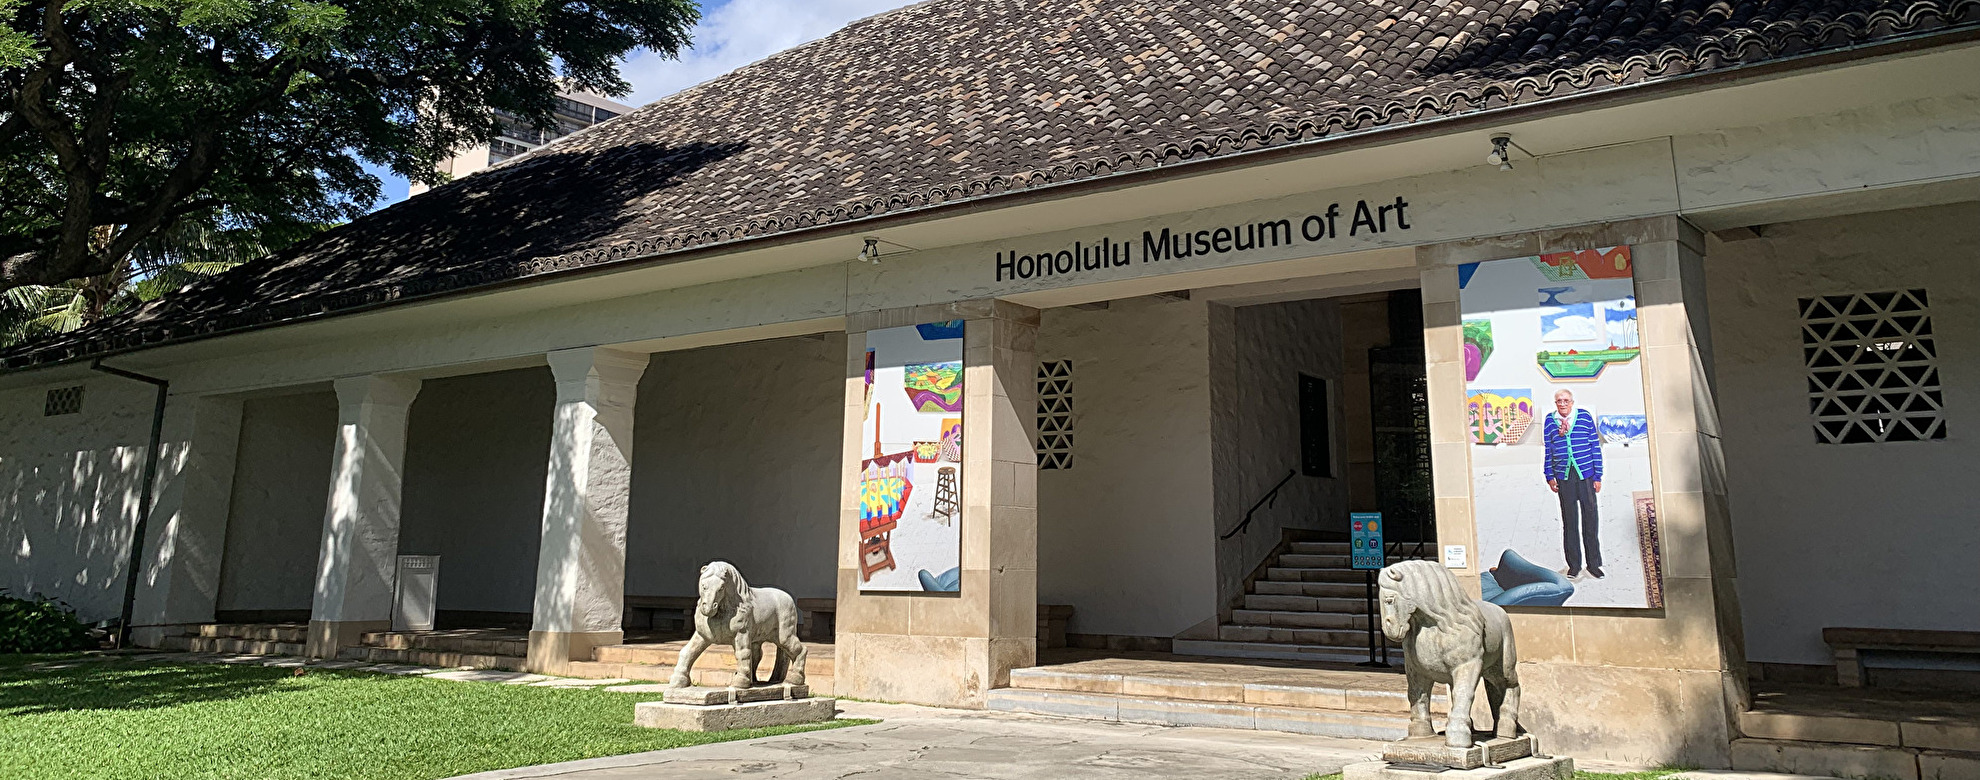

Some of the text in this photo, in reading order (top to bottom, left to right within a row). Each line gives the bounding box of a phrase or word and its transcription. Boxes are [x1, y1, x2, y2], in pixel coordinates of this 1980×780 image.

[995, 196, 1411, 282] Honolulu Museum of Art
